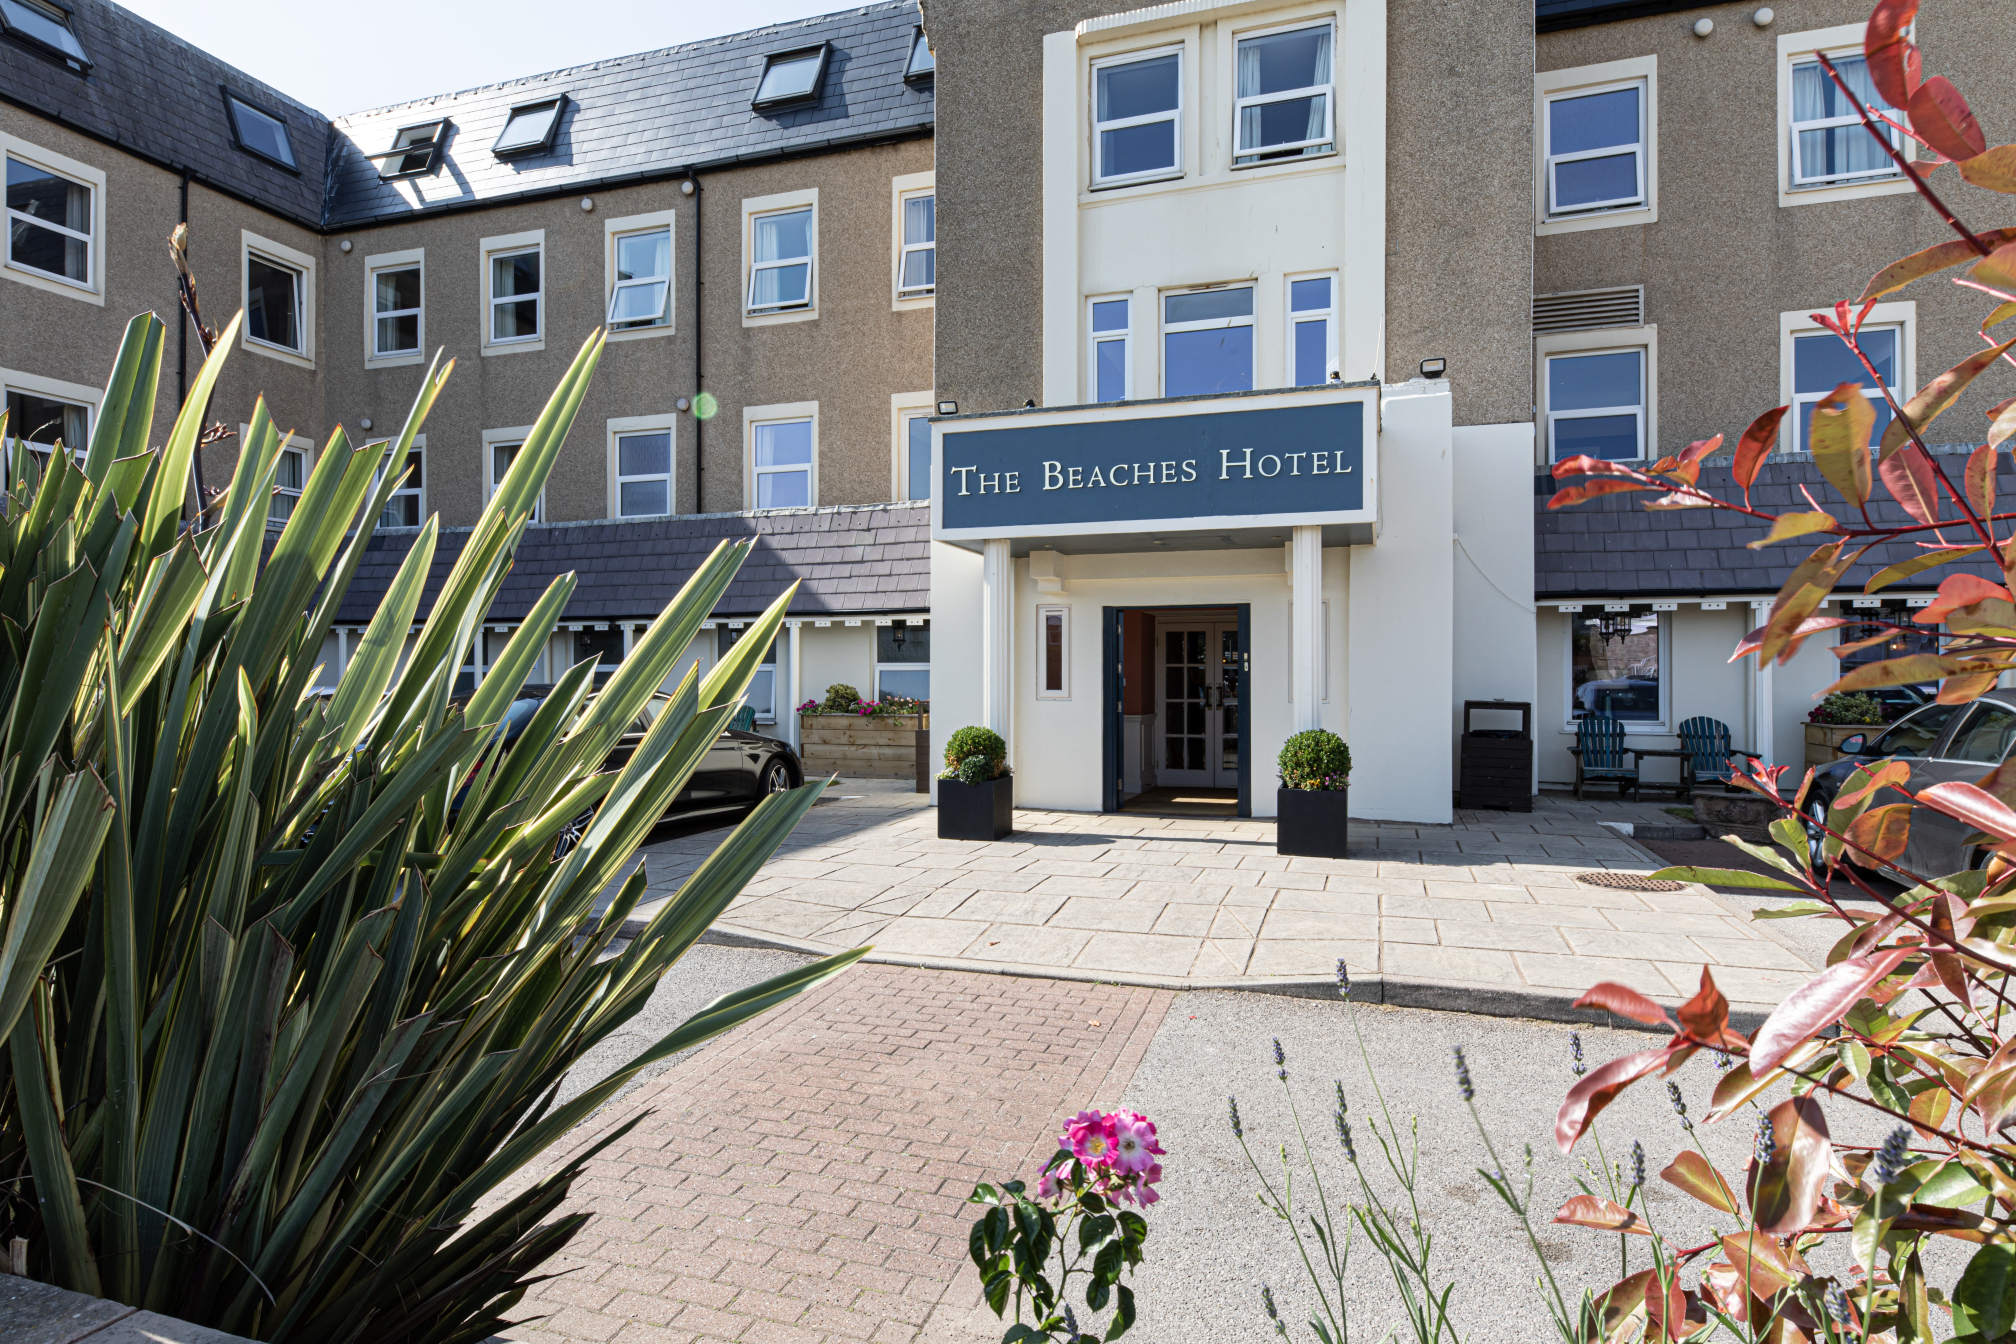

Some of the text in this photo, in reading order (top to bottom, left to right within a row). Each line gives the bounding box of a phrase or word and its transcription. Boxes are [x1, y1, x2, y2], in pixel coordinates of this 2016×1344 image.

[950, 448, 1353, 496] THE BEACHES HOTEL
